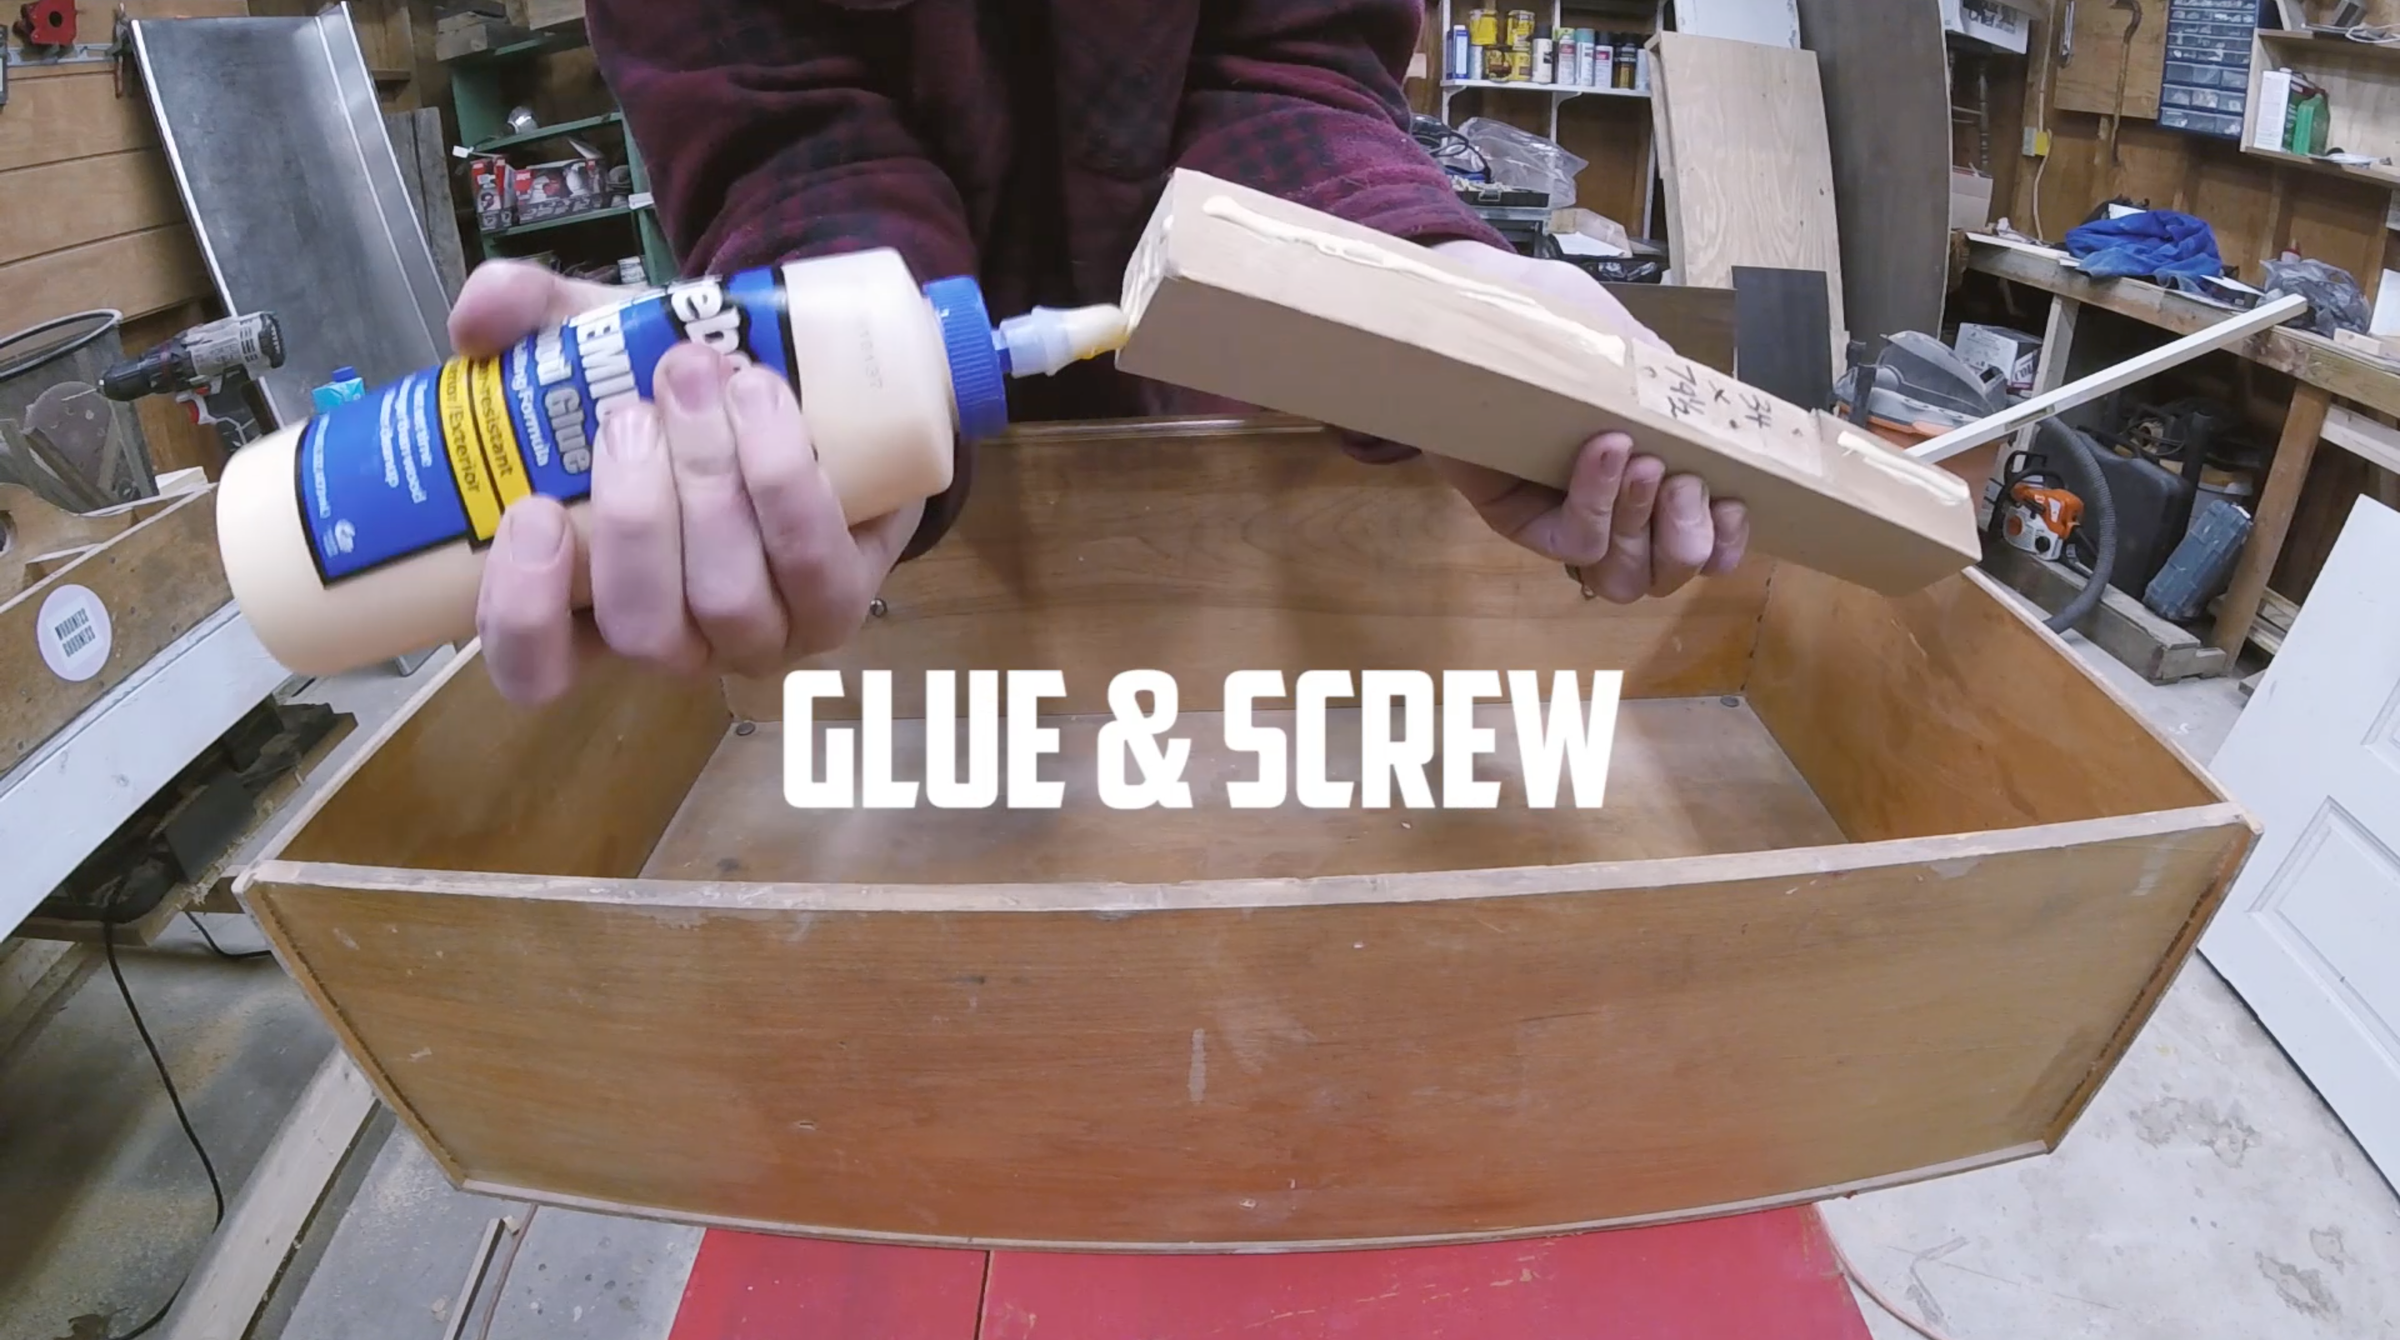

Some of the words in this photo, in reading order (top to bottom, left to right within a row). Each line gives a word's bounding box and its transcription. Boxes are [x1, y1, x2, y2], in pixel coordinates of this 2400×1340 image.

[518, 386, 550, 467] Formula
[546, 388, 591, 474] Glue
[1739, 393, 1772, 428] 34
